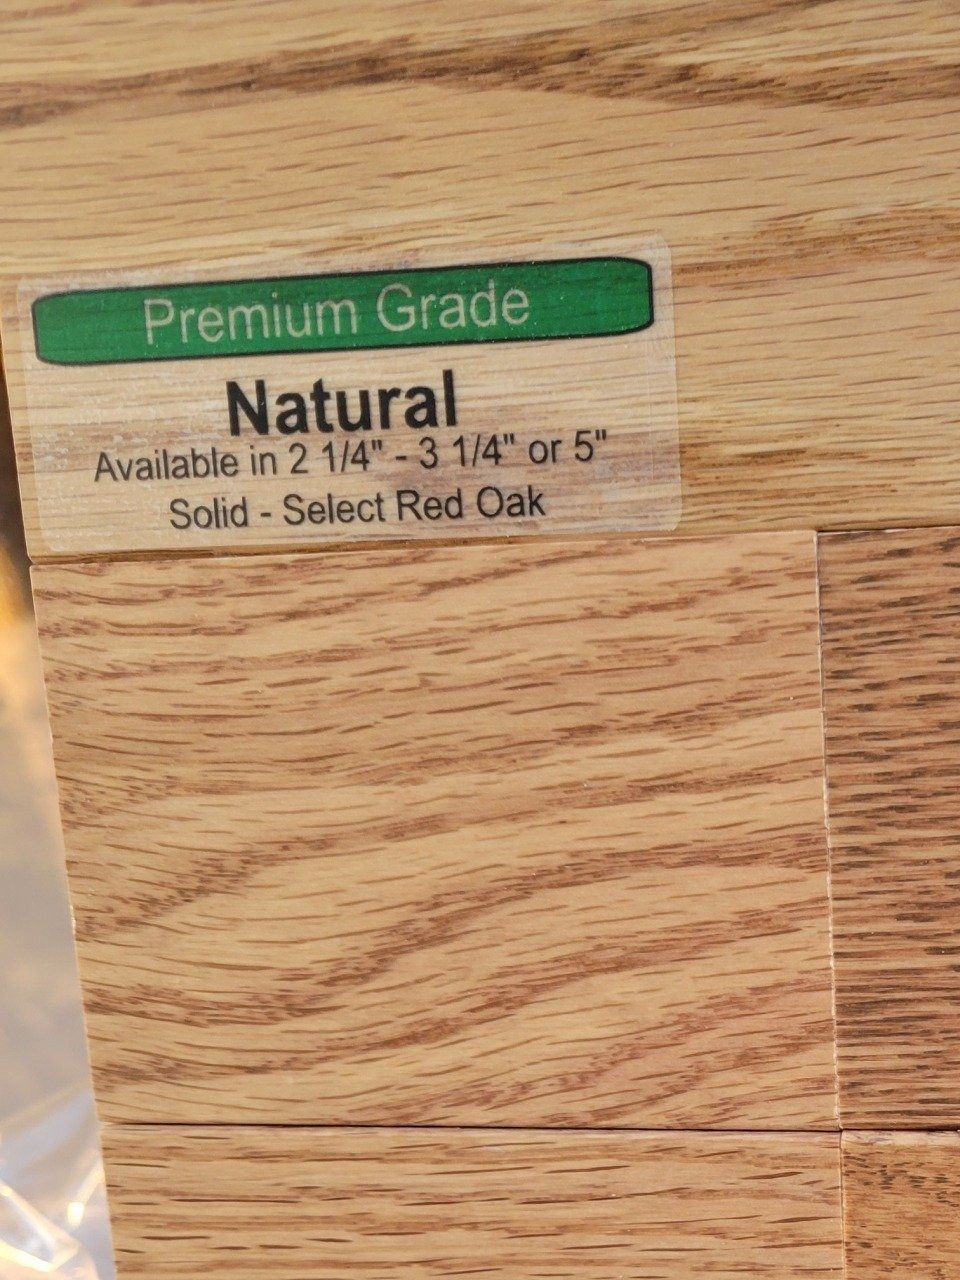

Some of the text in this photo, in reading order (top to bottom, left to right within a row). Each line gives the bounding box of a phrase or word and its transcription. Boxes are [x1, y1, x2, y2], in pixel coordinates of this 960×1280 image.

[143, 279, 530, 345] Premium Grade
[225, 369, 458, 437] Natural
[94, 437, 239, 483] Available
[250, 444, 278, 475] in
[289, 443, 307, 474] 2
[327, 433, 384, 474] 1/4"
[419, 438, 438, 468] 3
[457, 433, 515, 466] 1/4"
[528, 438, 562, 464] or
[574, 429, 608, 462] 5"
[169, 494, 249, 530] Solid
[282, 489, 386, 525] Select
[397, 488, 463, 521] Red
[476, 485, 546, 518] Oak
